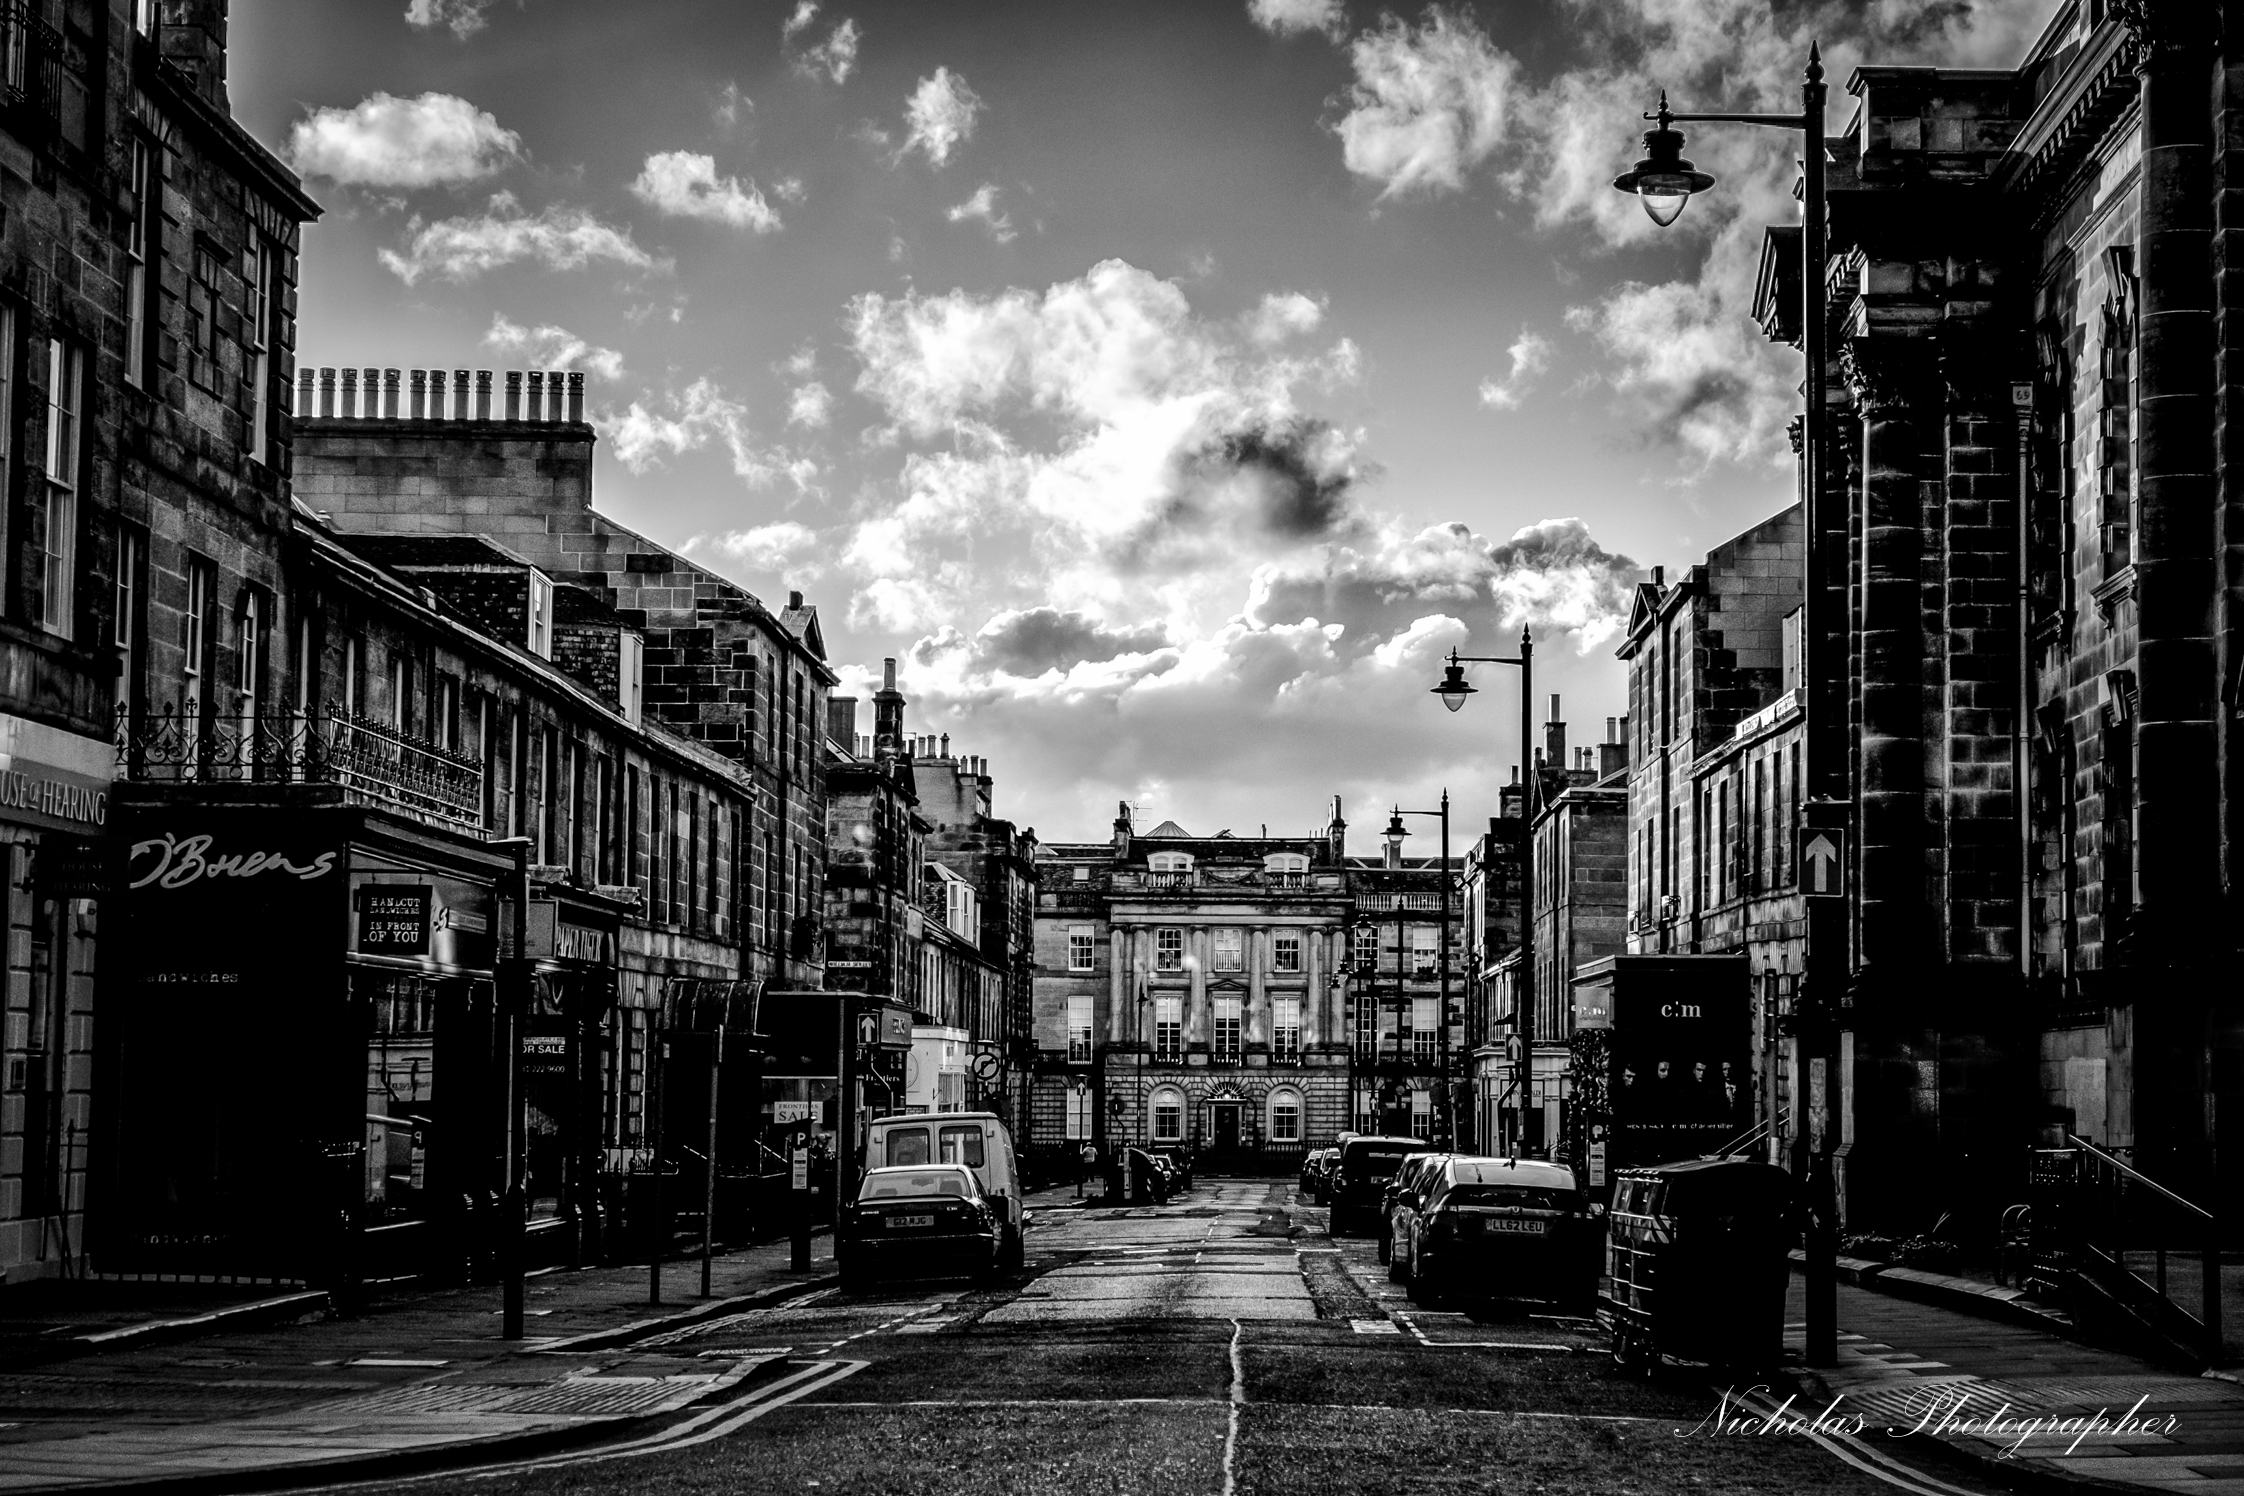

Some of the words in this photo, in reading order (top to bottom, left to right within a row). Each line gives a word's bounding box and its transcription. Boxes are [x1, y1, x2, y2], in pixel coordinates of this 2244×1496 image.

[41, 779, 106, 826] HEARING
[370, 921, 383, 931] IN
[387, 922, 420, 931] FRONT
[393, 931, 419, 943] YOU
[537, 1045, 565, 1054] SALE
[796, 1131, 807, 1146] P
[1493, 1220, 1520, 1231] LL62
[1521, 1220, 1543, 1232] LEU
